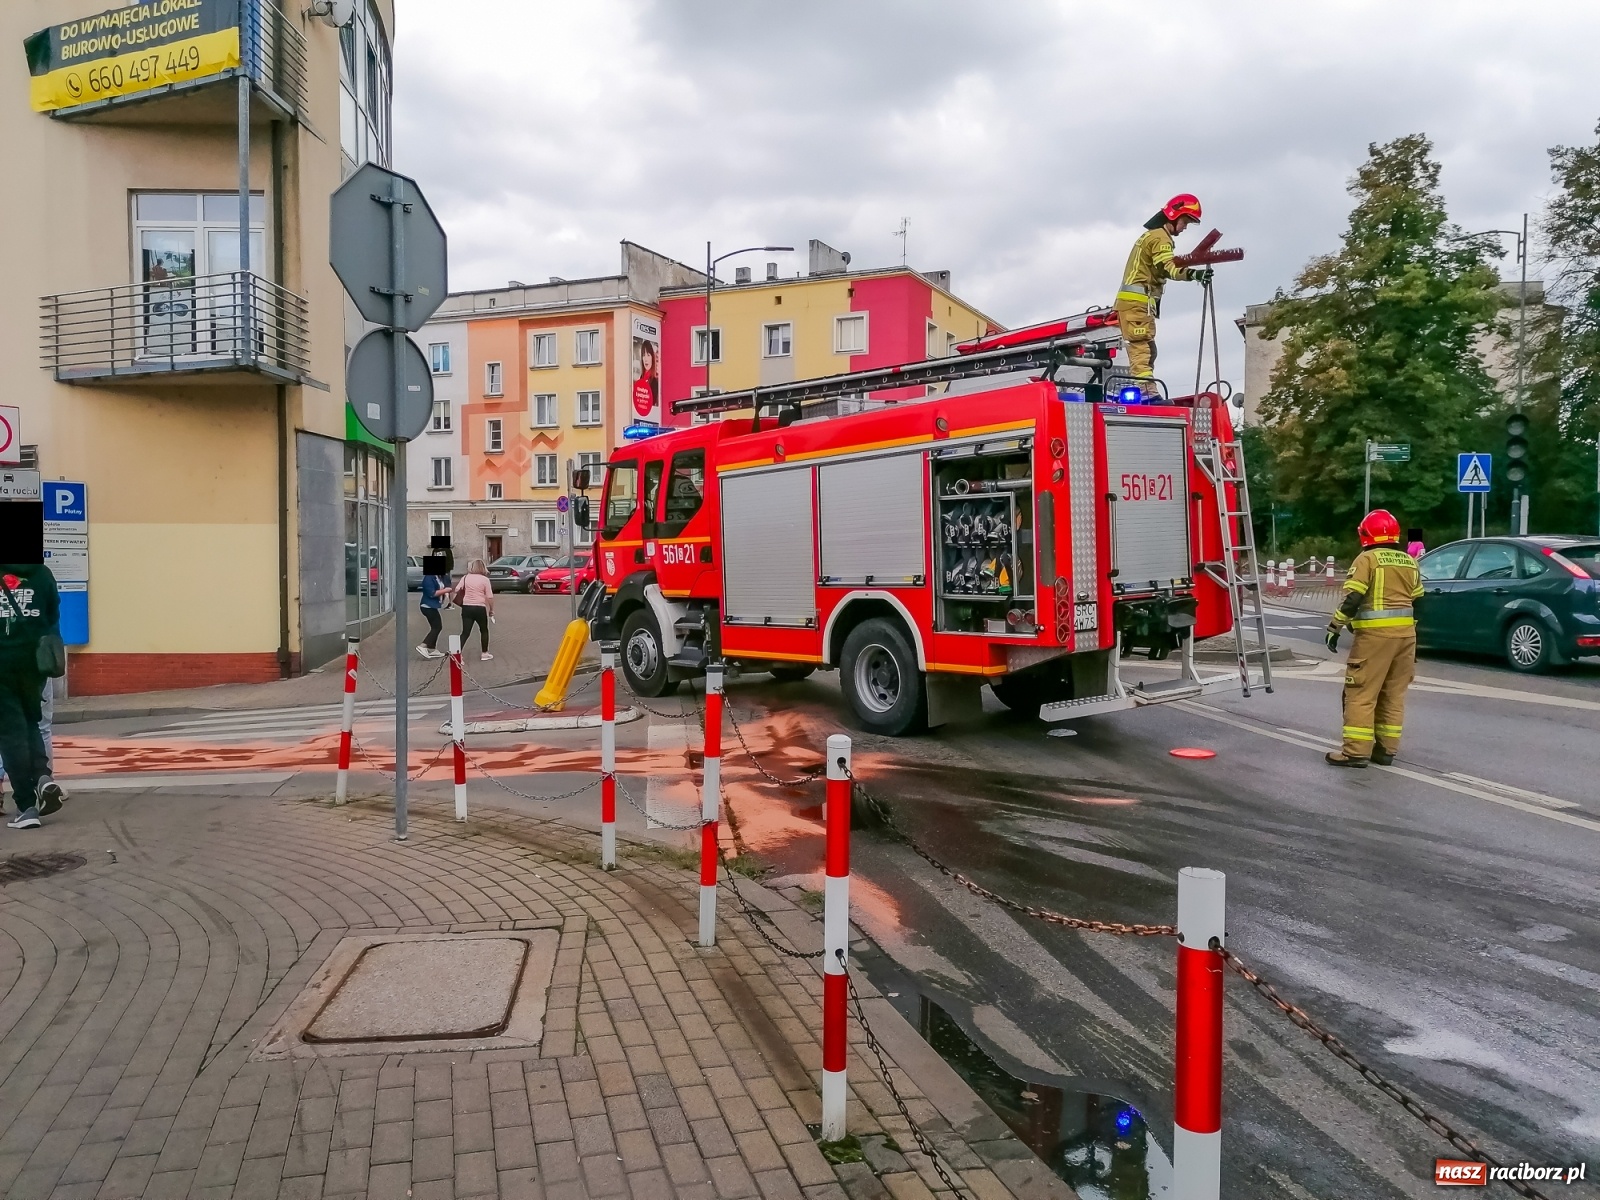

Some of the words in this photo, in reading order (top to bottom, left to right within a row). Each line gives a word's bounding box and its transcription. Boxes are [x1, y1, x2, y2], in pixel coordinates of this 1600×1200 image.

[60, 26, 78, 41] DO
[81, 5, 150, 32] WYNAJĘCIA
[61, 13, 200, 60] BIUROWO-USŁUGOWE
[89, 64, 123, 93] 660
[129, 55, 160, 83] 497
[165, 46, 200, 75] 449
[1076, 604, 1093, 616] SRC
